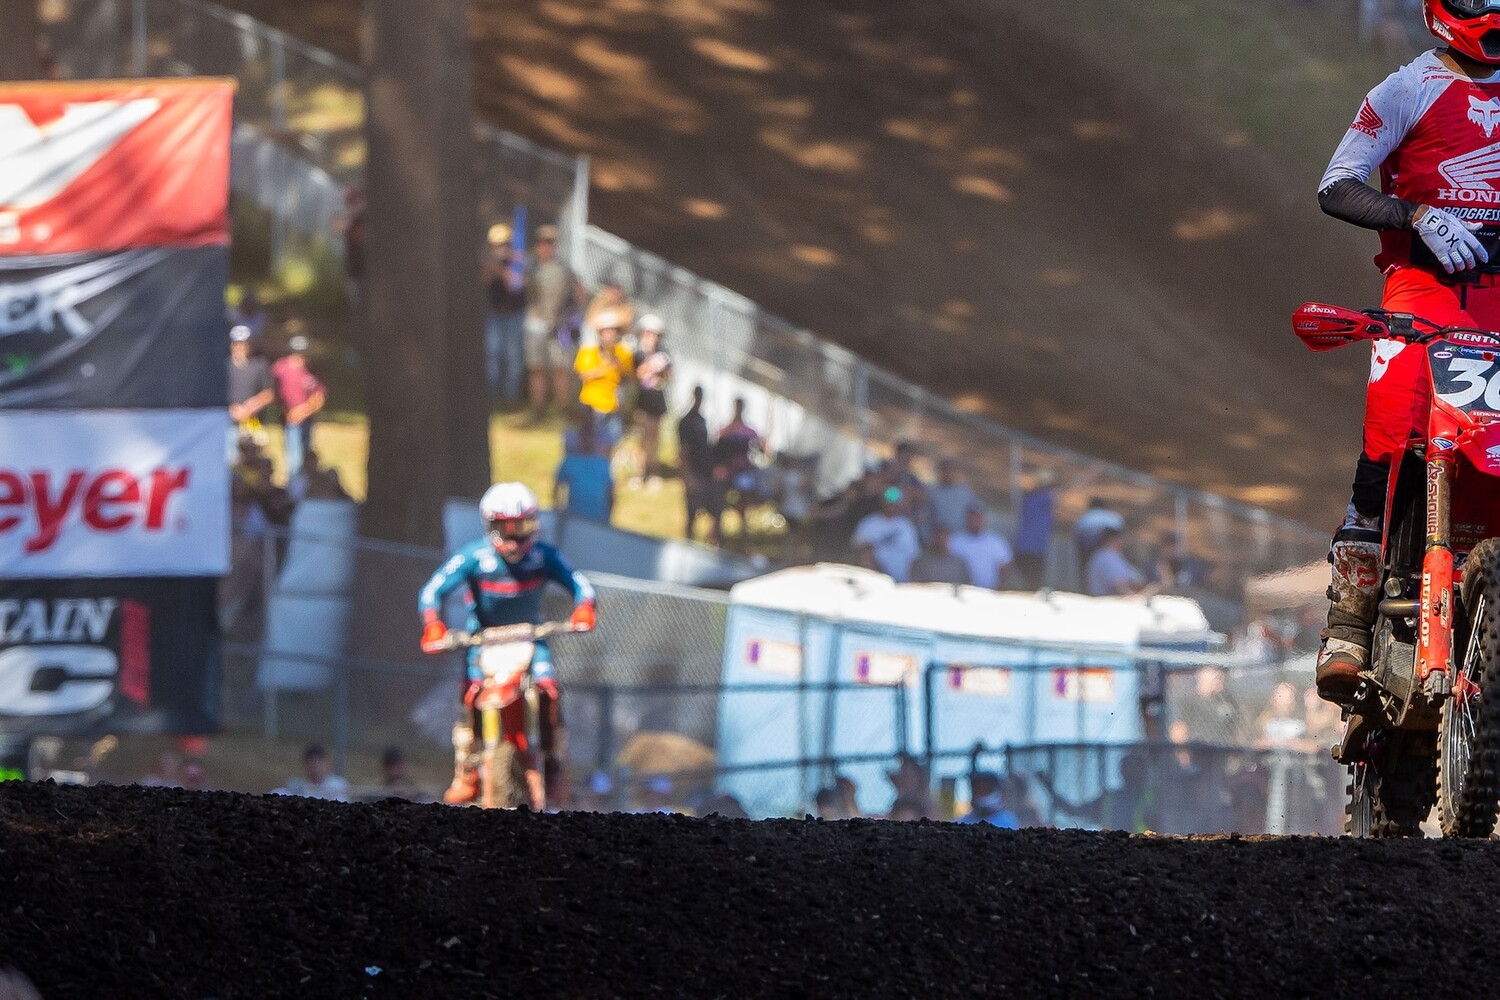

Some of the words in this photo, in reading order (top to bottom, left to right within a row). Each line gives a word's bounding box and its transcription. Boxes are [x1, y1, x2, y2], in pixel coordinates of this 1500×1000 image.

[1350, 121, 1378, 140] ONDA
[1427, 215, 1459, 248] FOX
[1303, 307, 1337, 315] HONDA
[1427, 482, 1440, 536] SHOWA
[1421, 572, 1431, 648] DUNLOP
